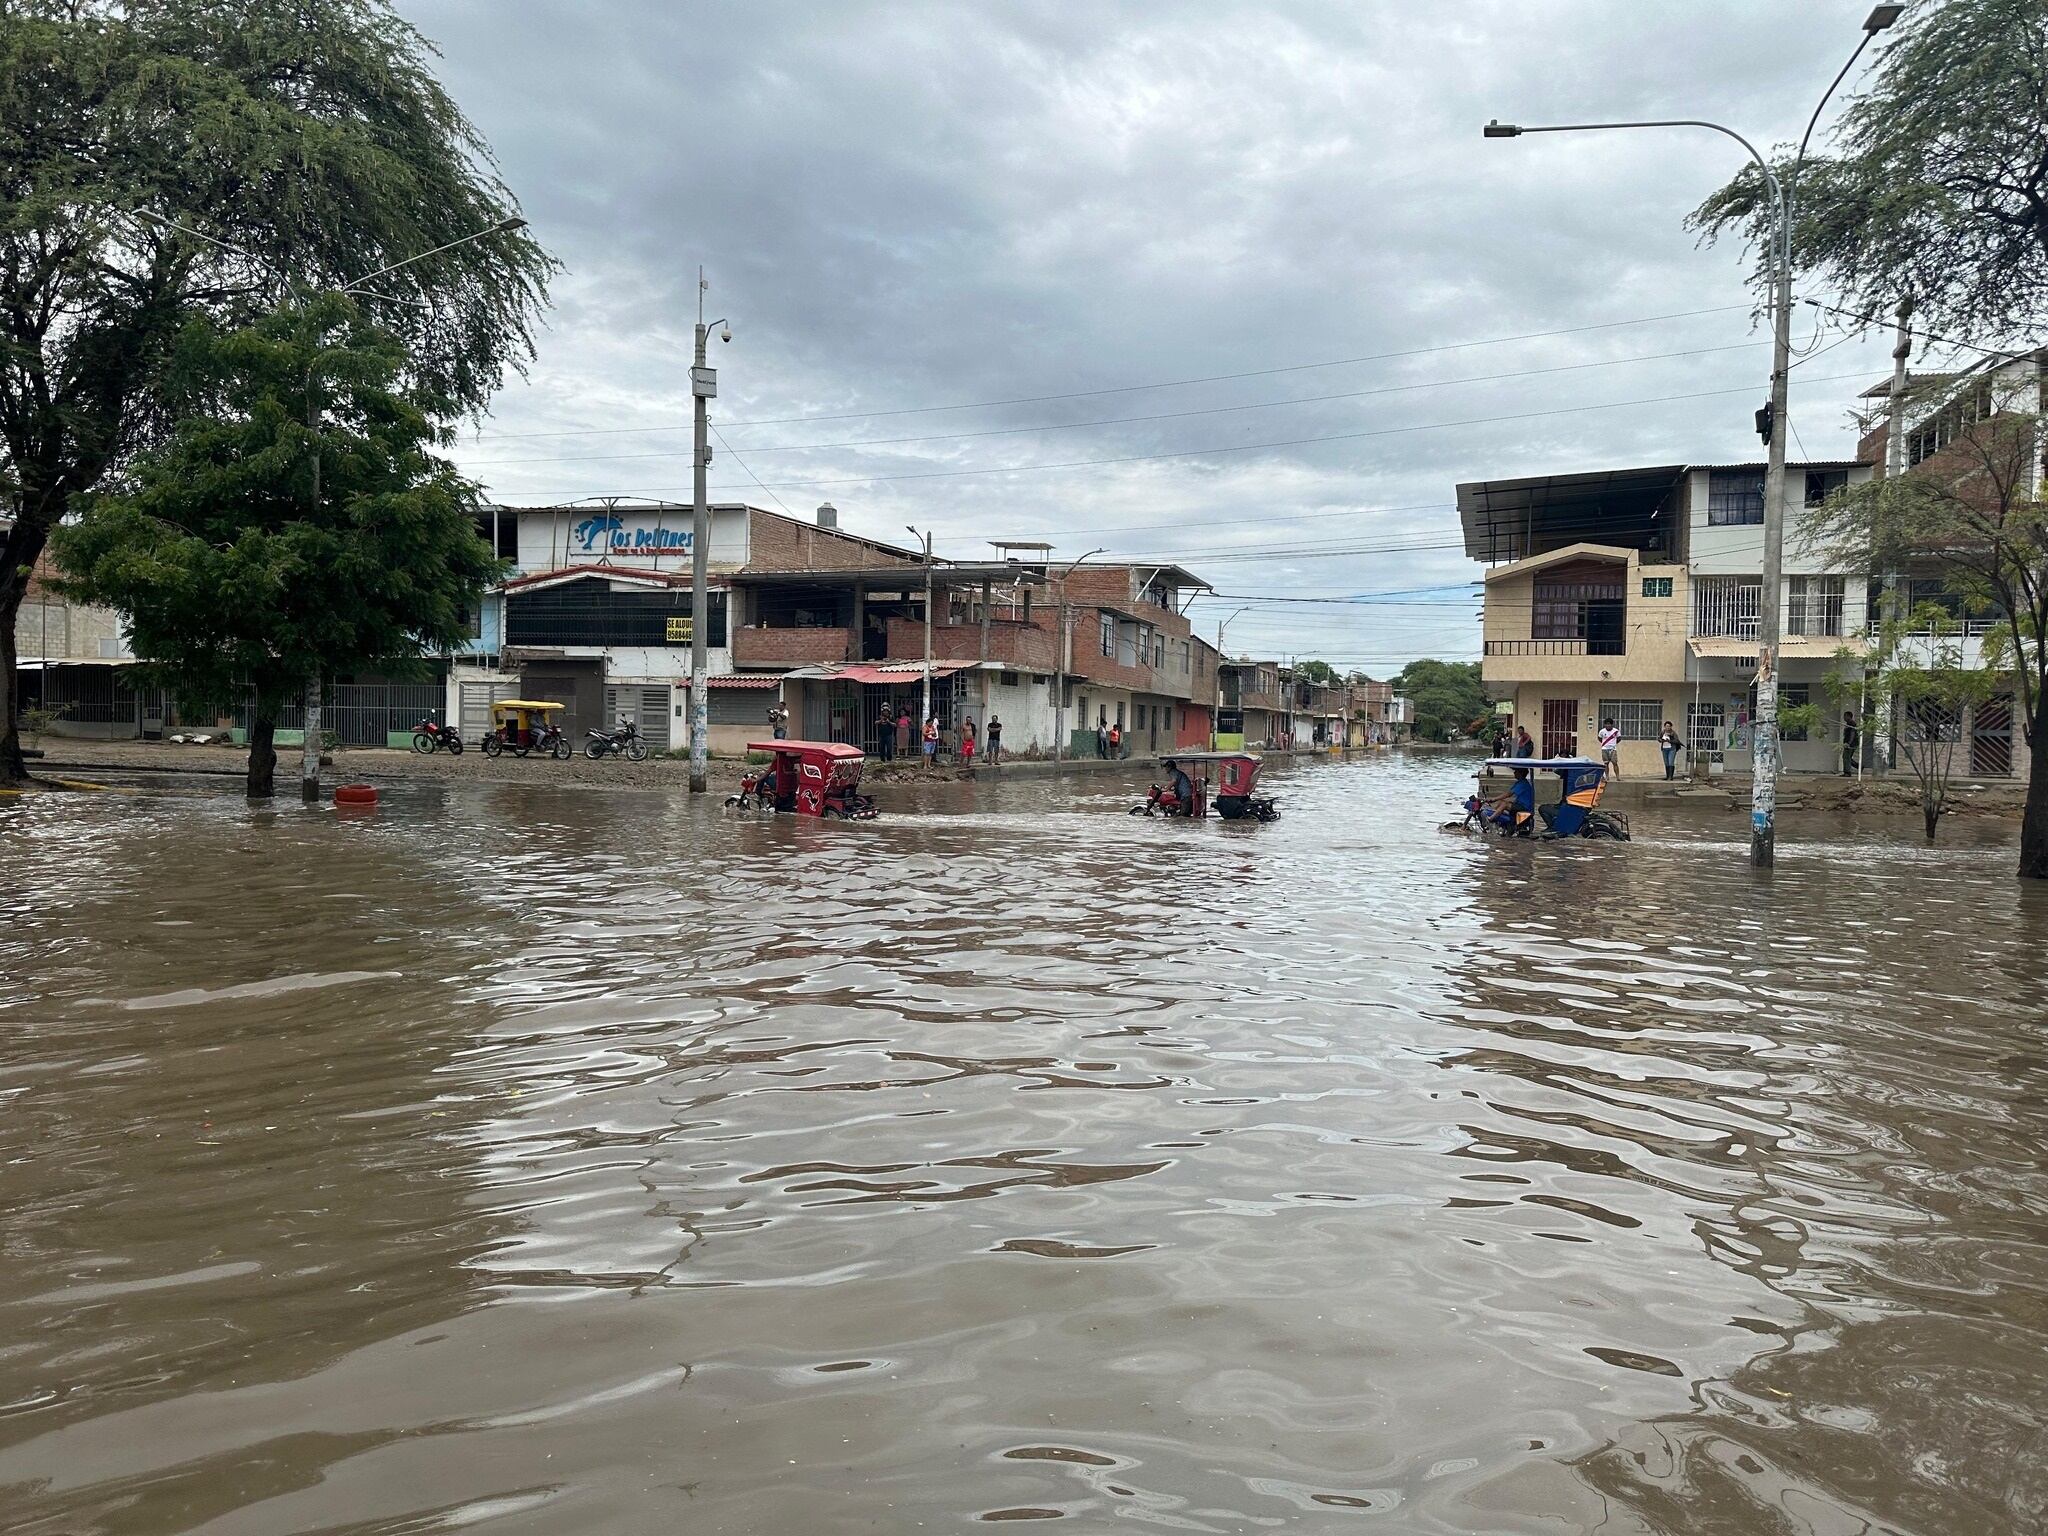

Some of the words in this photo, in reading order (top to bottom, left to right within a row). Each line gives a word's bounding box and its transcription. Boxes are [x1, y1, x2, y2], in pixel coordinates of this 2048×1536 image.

[635, 528, 693, 547] Delfines
[667, 619, 674, 629] SE
[676, 619, 692, 629] ALQUI
